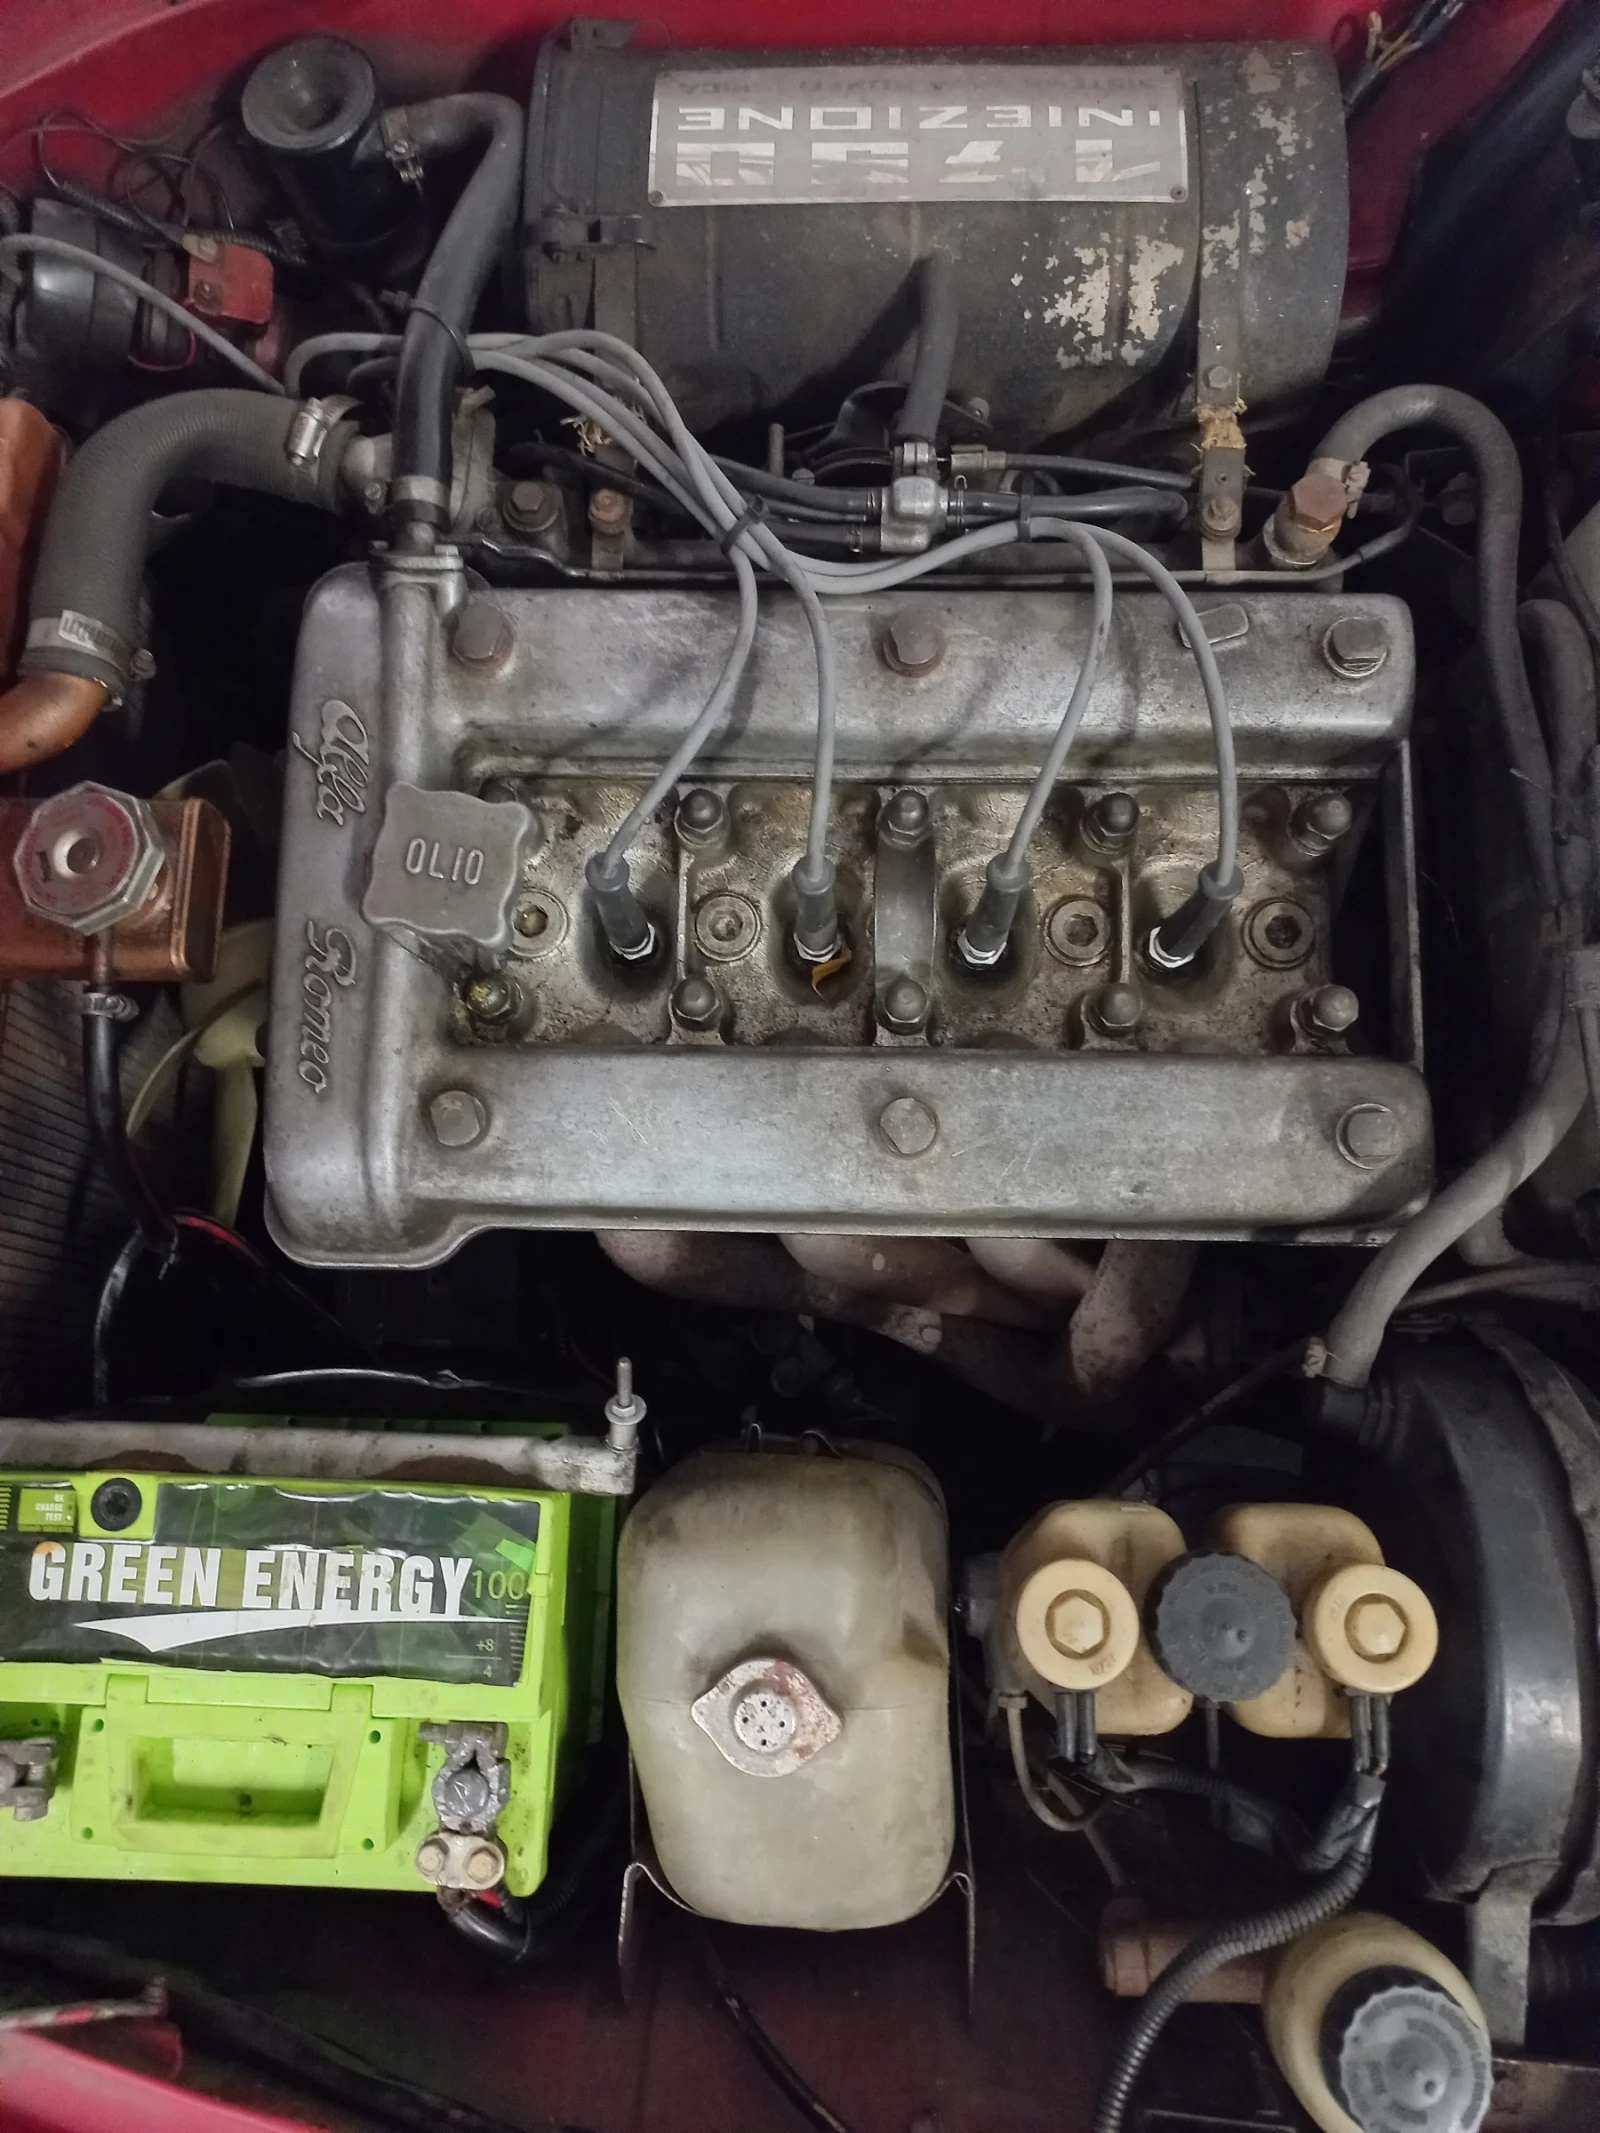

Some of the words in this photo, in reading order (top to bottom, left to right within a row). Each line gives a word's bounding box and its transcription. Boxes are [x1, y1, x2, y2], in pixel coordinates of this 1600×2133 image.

[677, 104, 1161, 130] INIEZIONE
[292, 700, 369, 827] Alfa
[405, 838, 485, 886] OLIO
[299, 919, 357, 1094] Romeo
[28, 1541, 223, 1607] GREEN
[242, 1549, 473, 1616] ENERGY
